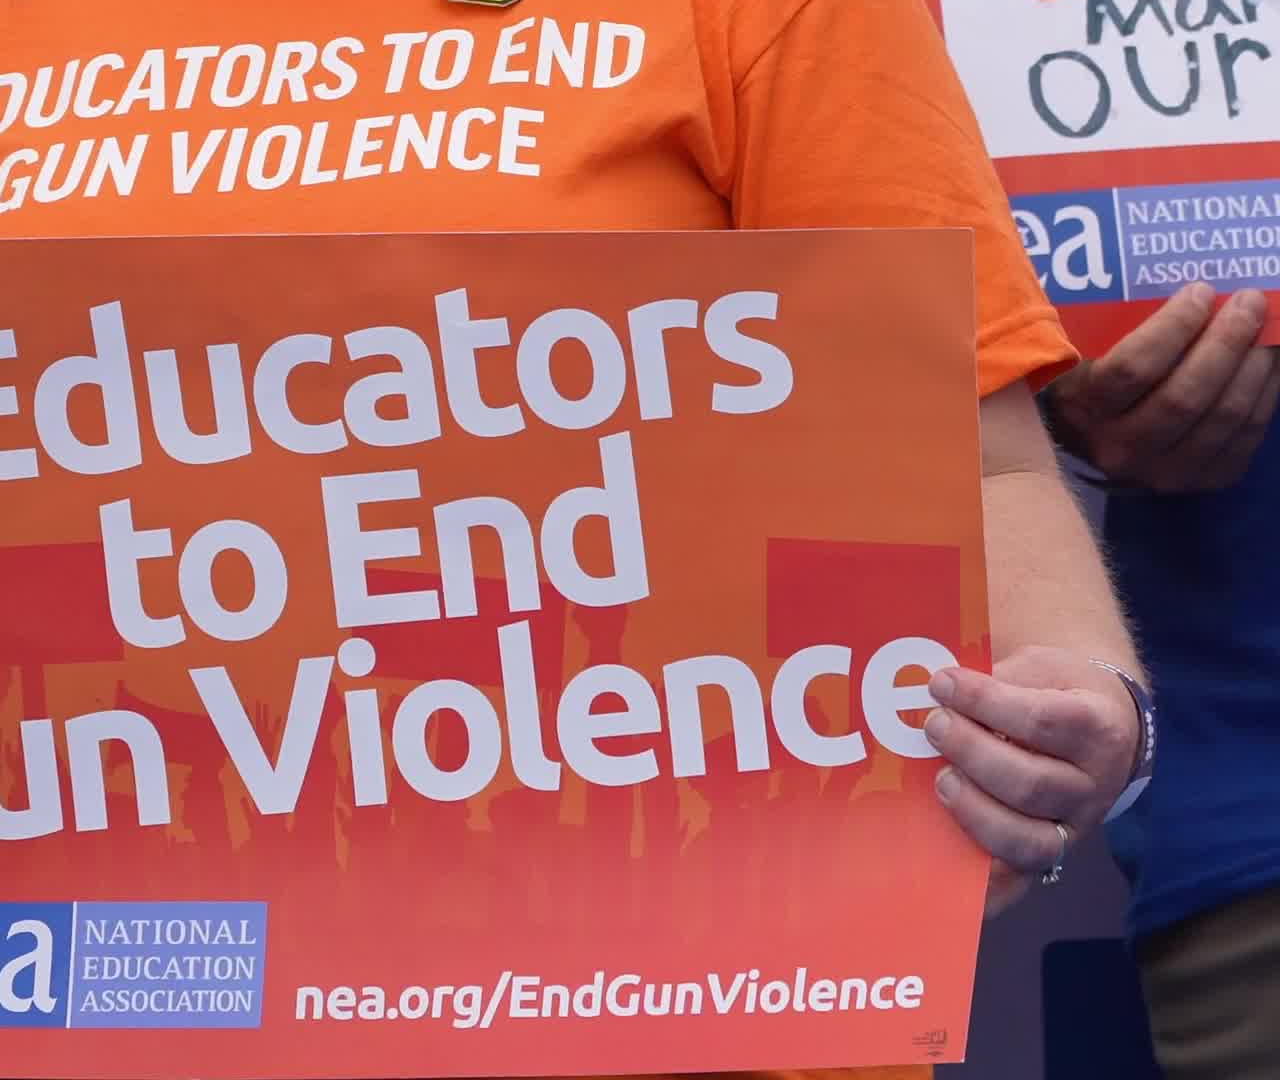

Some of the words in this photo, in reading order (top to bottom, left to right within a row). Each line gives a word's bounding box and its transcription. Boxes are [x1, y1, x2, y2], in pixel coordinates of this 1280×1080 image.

[383, 28, 473, 94] TO
[488, 16, 646, 90] END
[170, 106, 545, 195] VIOLENCE
[99, 499, 289, 649] to
[321, 431, 650, 629] End
[190, 621, 960, 816] Violence
[84, 919, 256, 945] NATIONAL
[80, 989, 253, 1013] ASSOCIATION
[82, 956, 255, 980] EDUCATION
[295, 967, 925, 1029] nea.org/EndGunViolence
